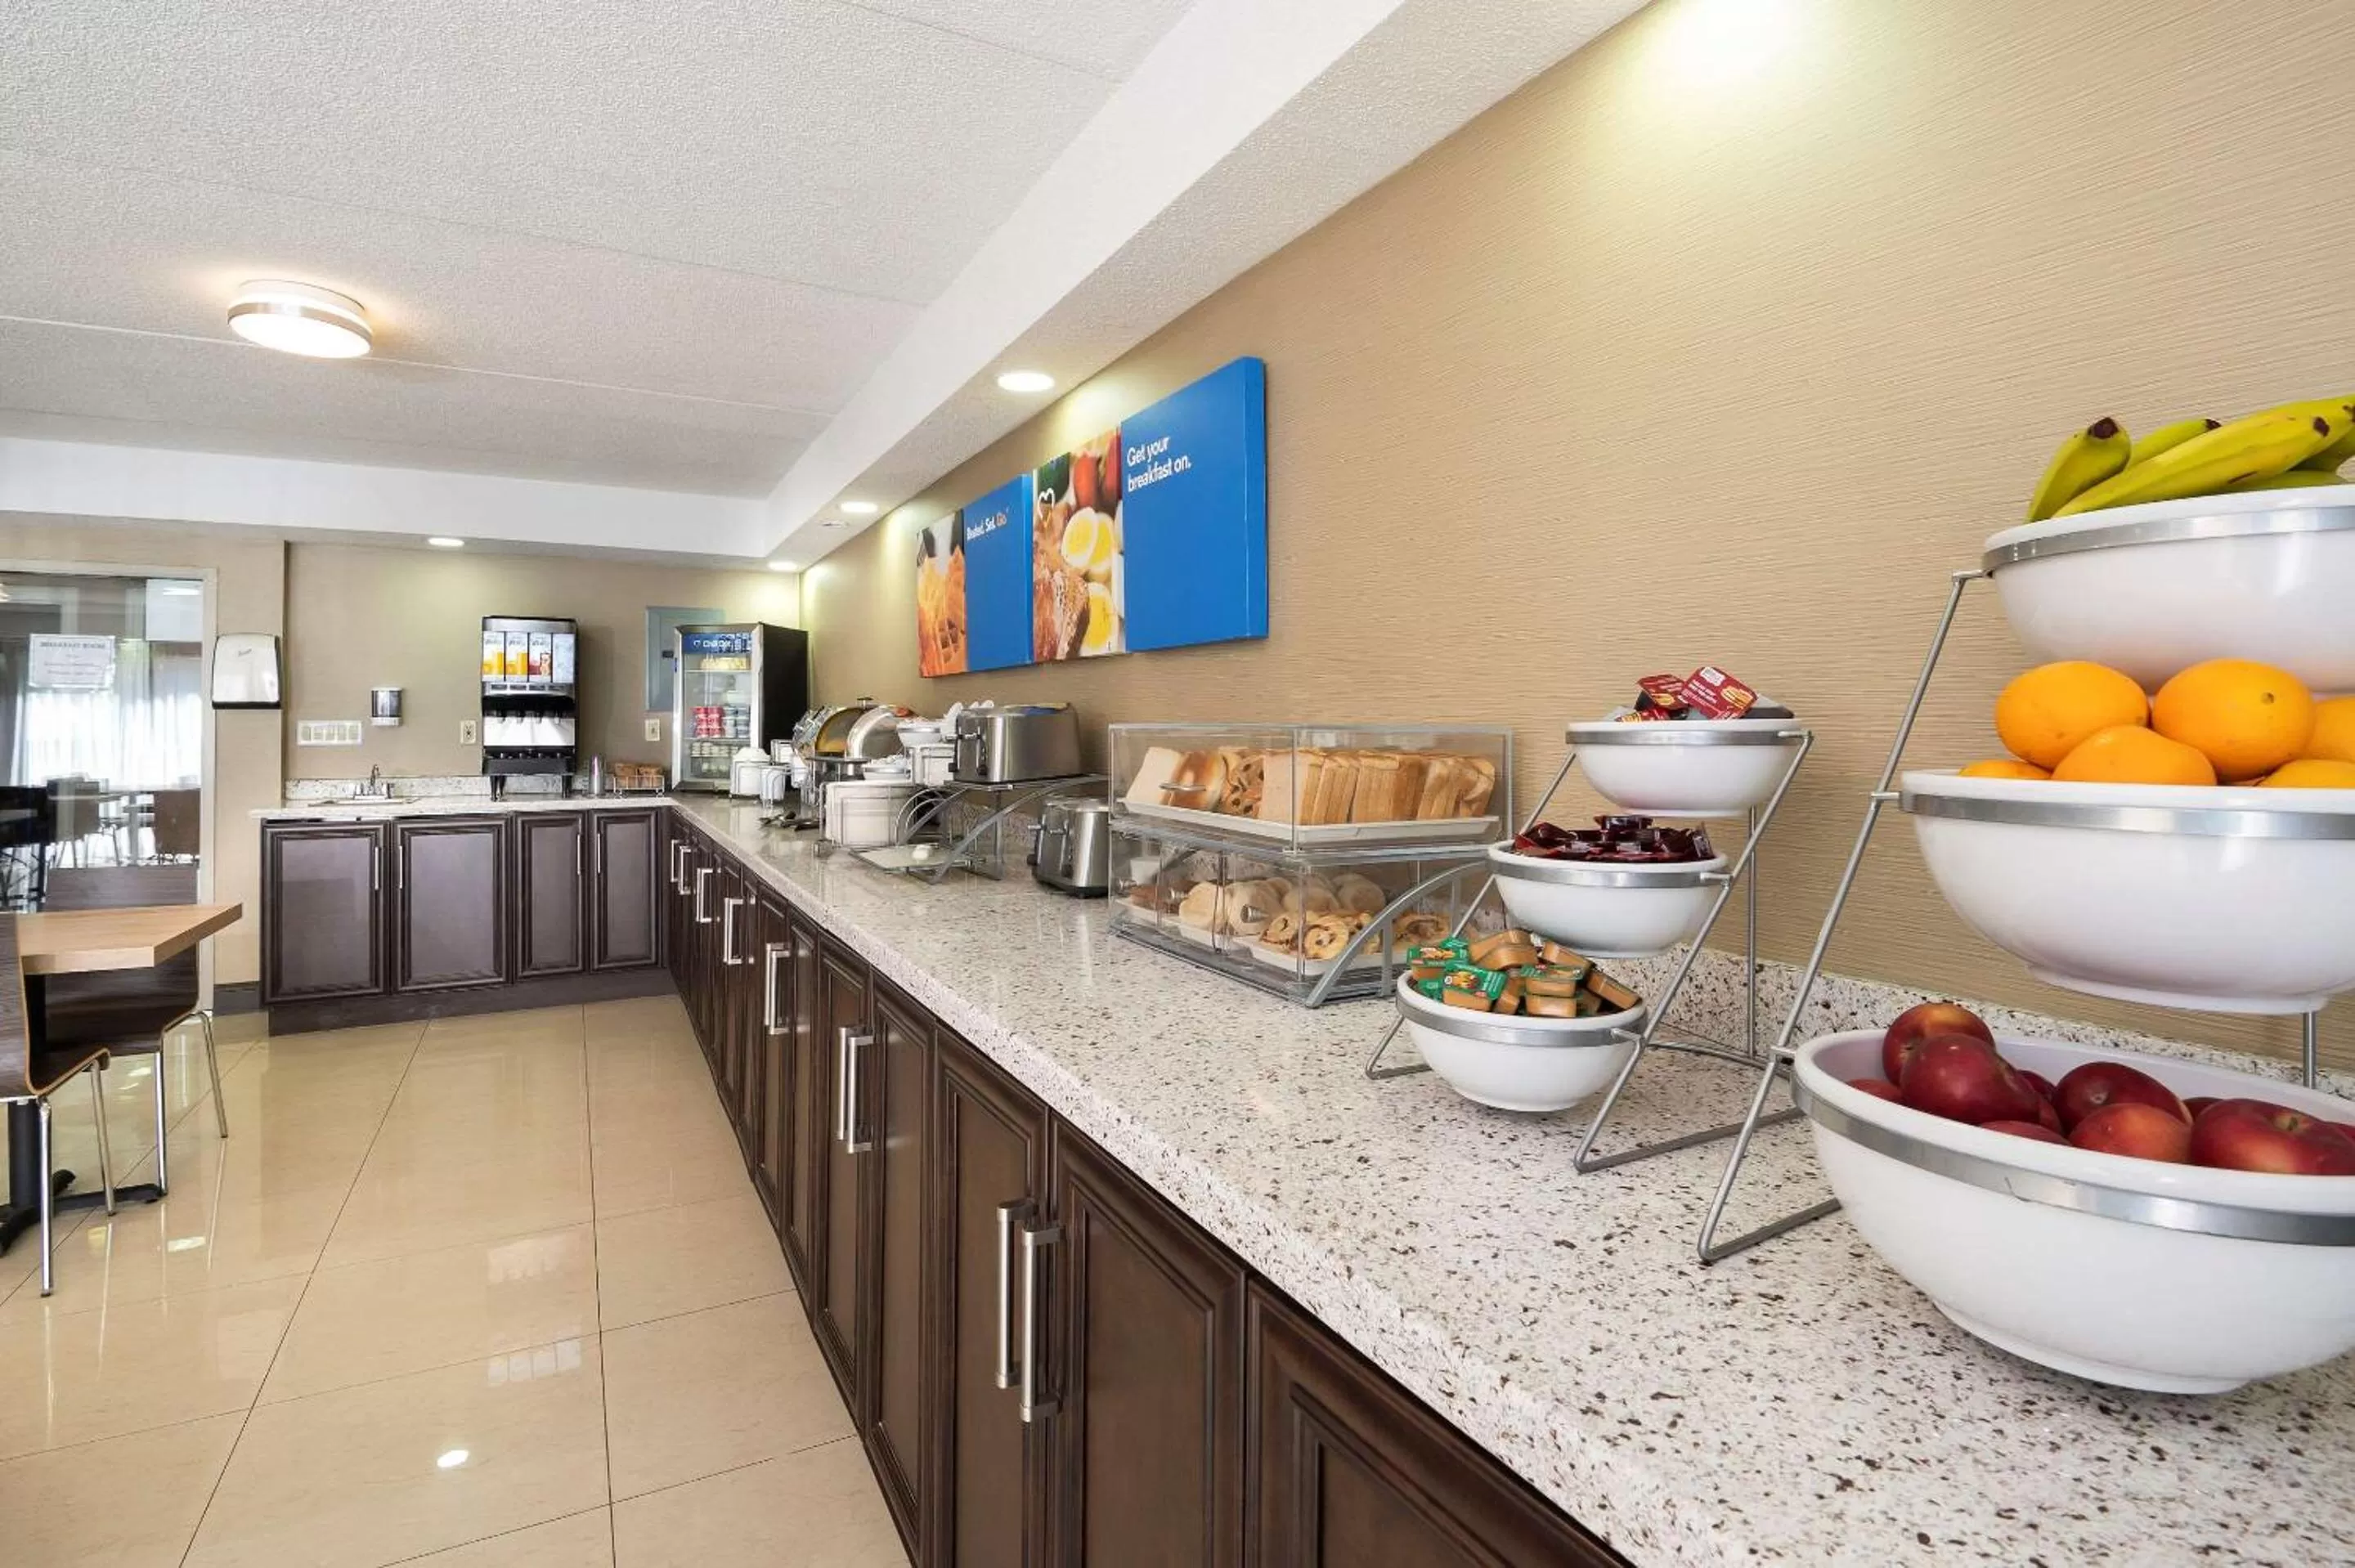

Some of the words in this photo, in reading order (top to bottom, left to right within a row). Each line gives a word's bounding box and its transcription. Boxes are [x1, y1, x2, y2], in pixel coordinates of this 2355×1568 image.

[1127, 443, 1146, 467] Get
[1146, 436, 1170, 464] your
[1128, 457, 1172, 492] breakfast
[1173, 455, 1192, 473] on.
